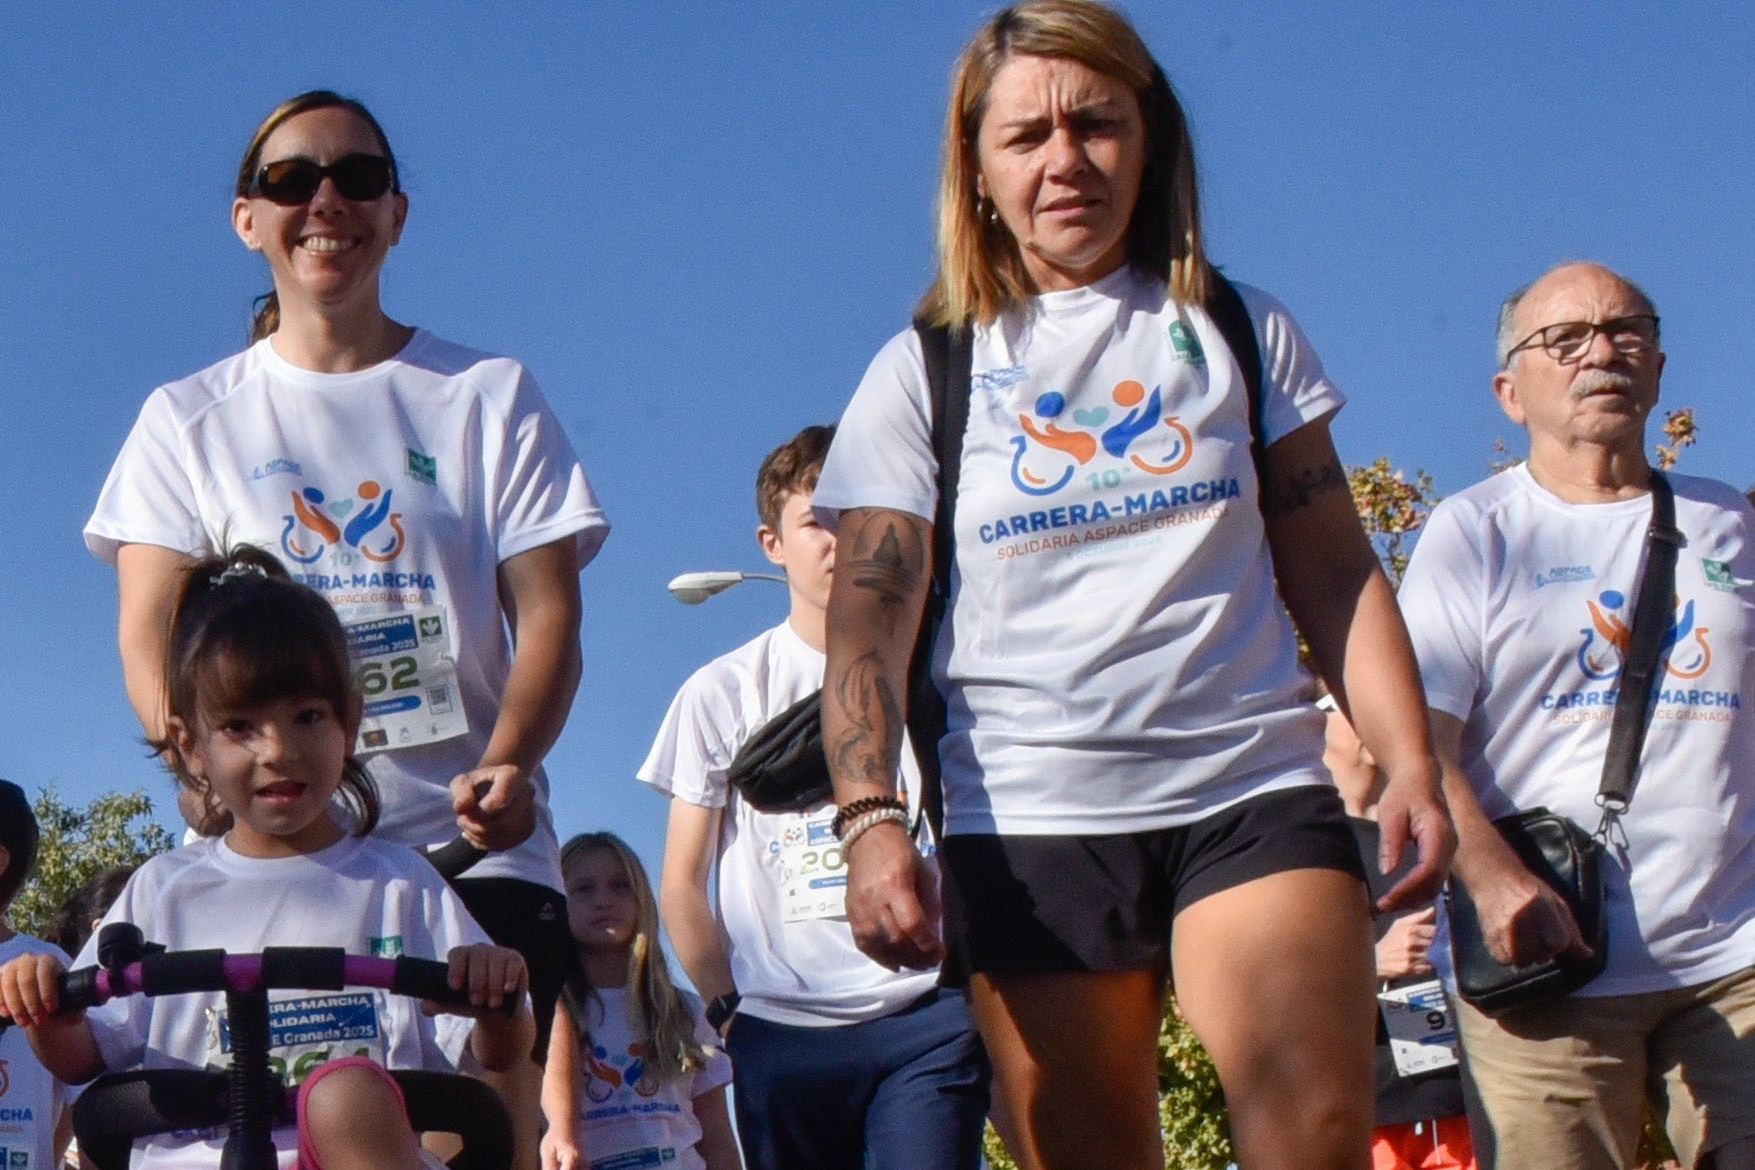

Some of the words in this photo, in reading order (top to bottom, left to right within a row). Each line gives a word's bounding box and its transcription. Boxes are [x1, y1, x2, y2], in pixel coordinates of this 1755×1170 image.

[979, 478, 1241, 544] CARRERA-MARCHA
[997, 532, 1079, 561] SOLIDARIA
[1083, 515, 1150, 543] ASPACE
[1153, 506, 1231, 531] GRANADA
[295, 572, 436, 590] RERA-MARCHA
[284, 1029, 341, 1044] Granada
